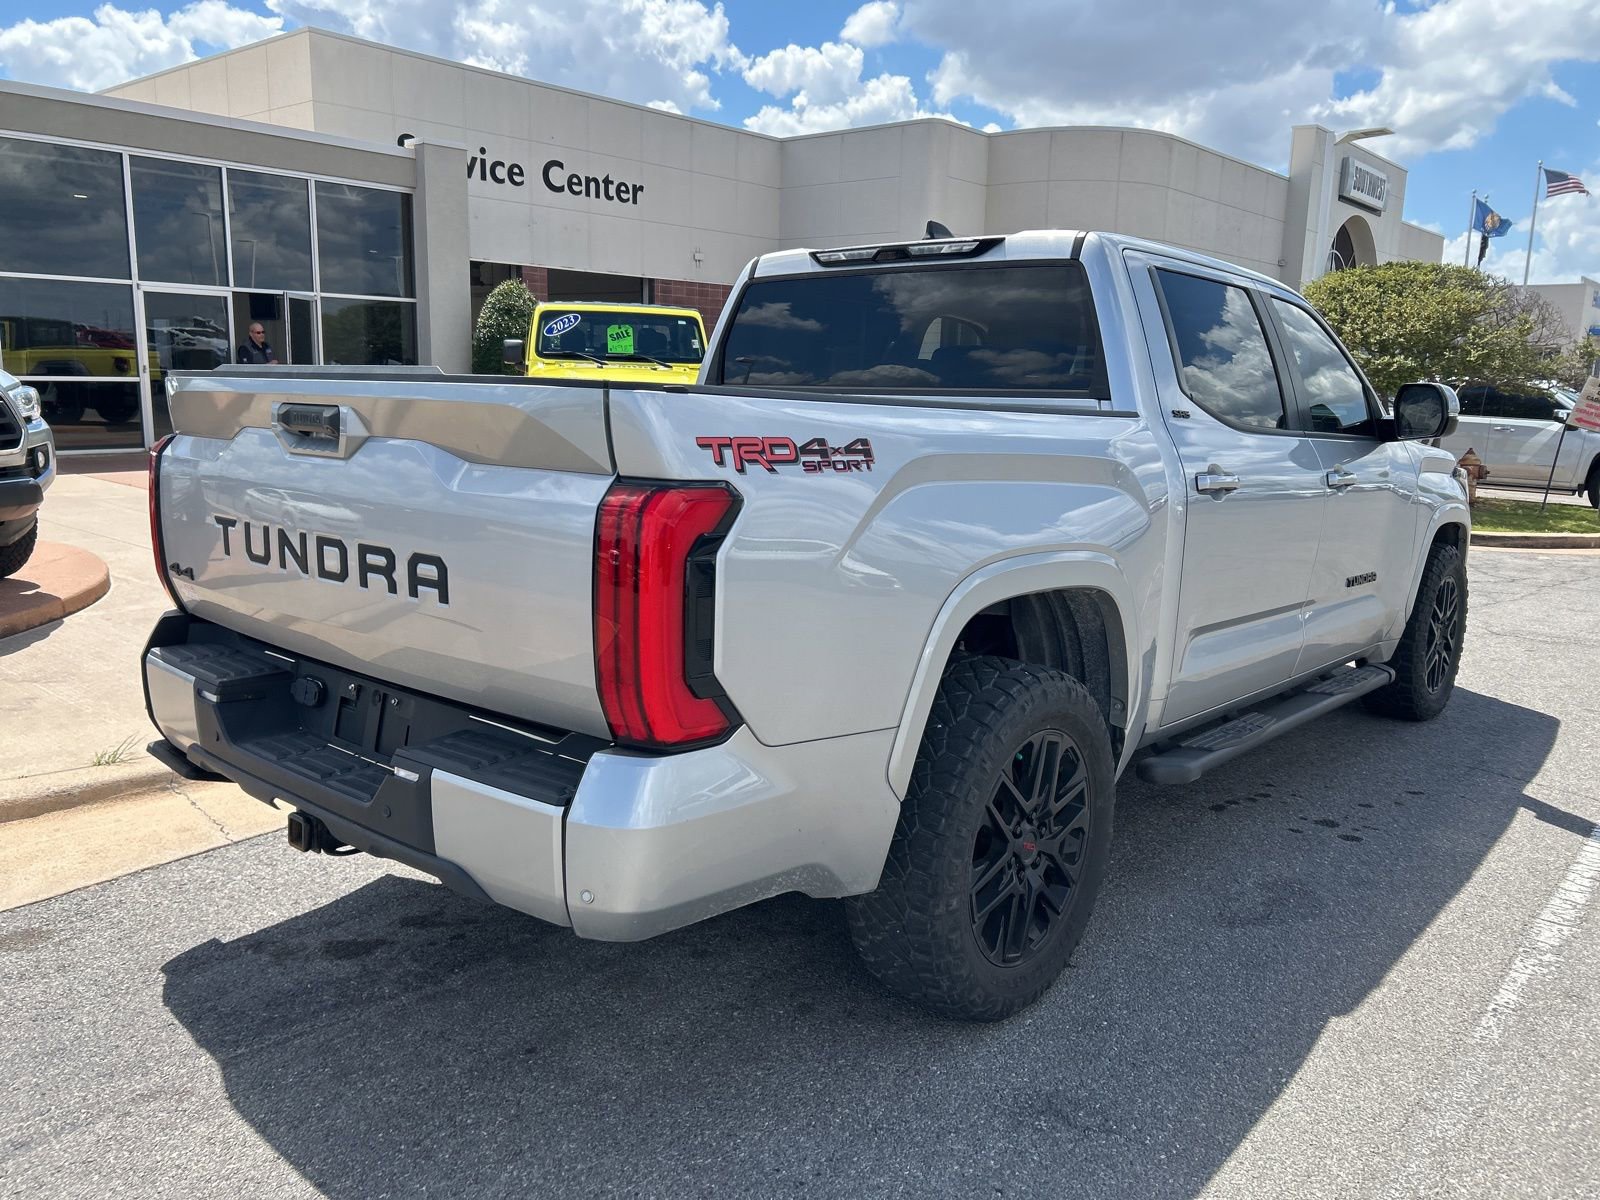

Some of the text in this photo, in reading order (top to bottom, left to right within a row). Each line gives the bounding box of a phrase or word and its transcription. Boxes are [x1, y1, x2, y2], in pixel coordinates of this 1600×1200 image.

[542, 159, 645, 205] Center
[1352, 165, 1387, 202] SOUTHWEST
[551, 315, 575, 334] 2023
[609, 329, 632, 342] SALE
[696, 436, 801, 475] TRD
[802, 459, 875, 474] SPORT
[213, 514, 450, 606] TUNDRA
[1345, 570, 1377, 588] TUNDRA
